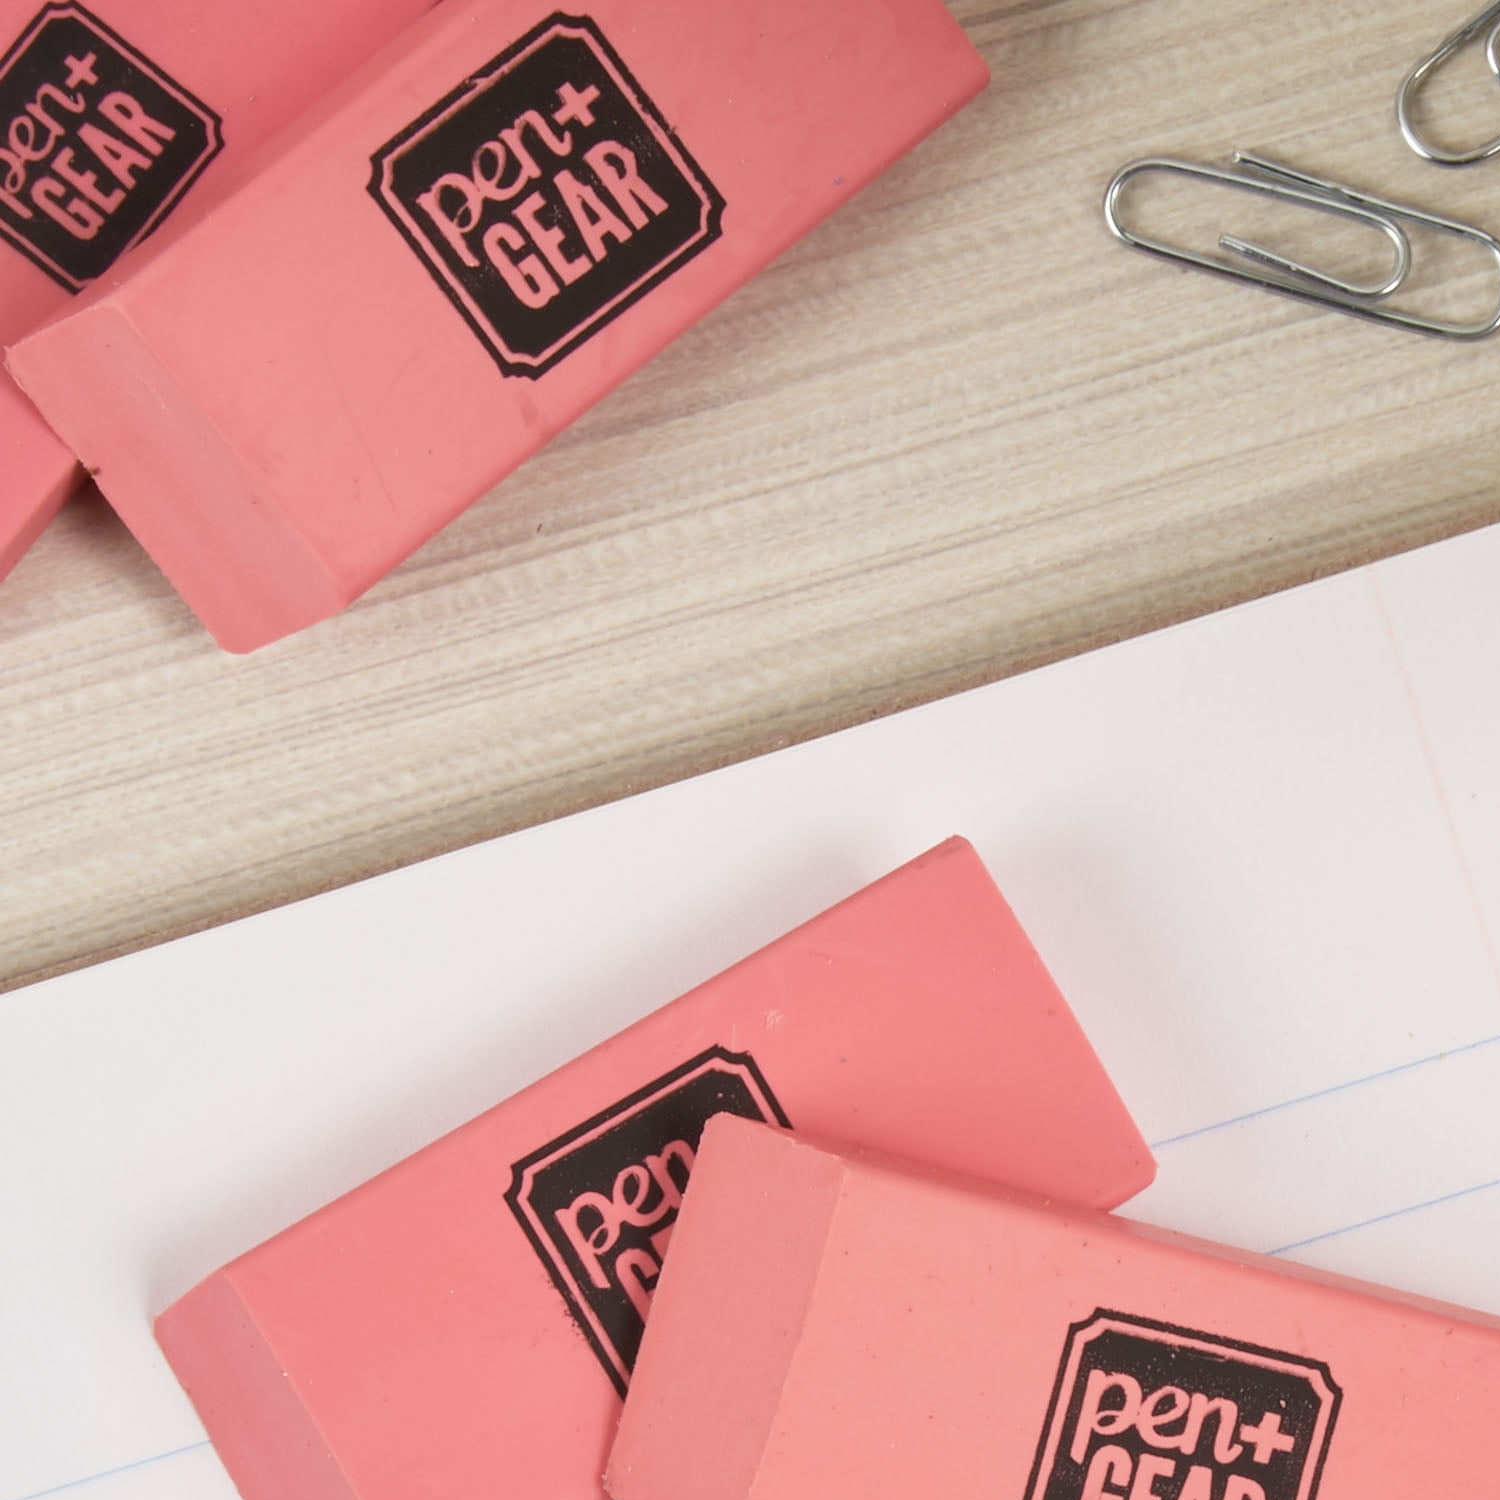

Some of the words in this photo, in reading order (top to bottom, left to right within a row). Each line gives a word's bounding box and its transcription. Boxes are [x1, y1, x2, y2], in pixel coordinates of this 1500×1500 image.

[30, 90, 177, 241] GEAR
[415, 81, 601, 268] pen+
[482, 139, 669, 310] GEAR
[553, 1138, 697, 1290] pen
[1069, 1368, 1296, 1465] pen+
